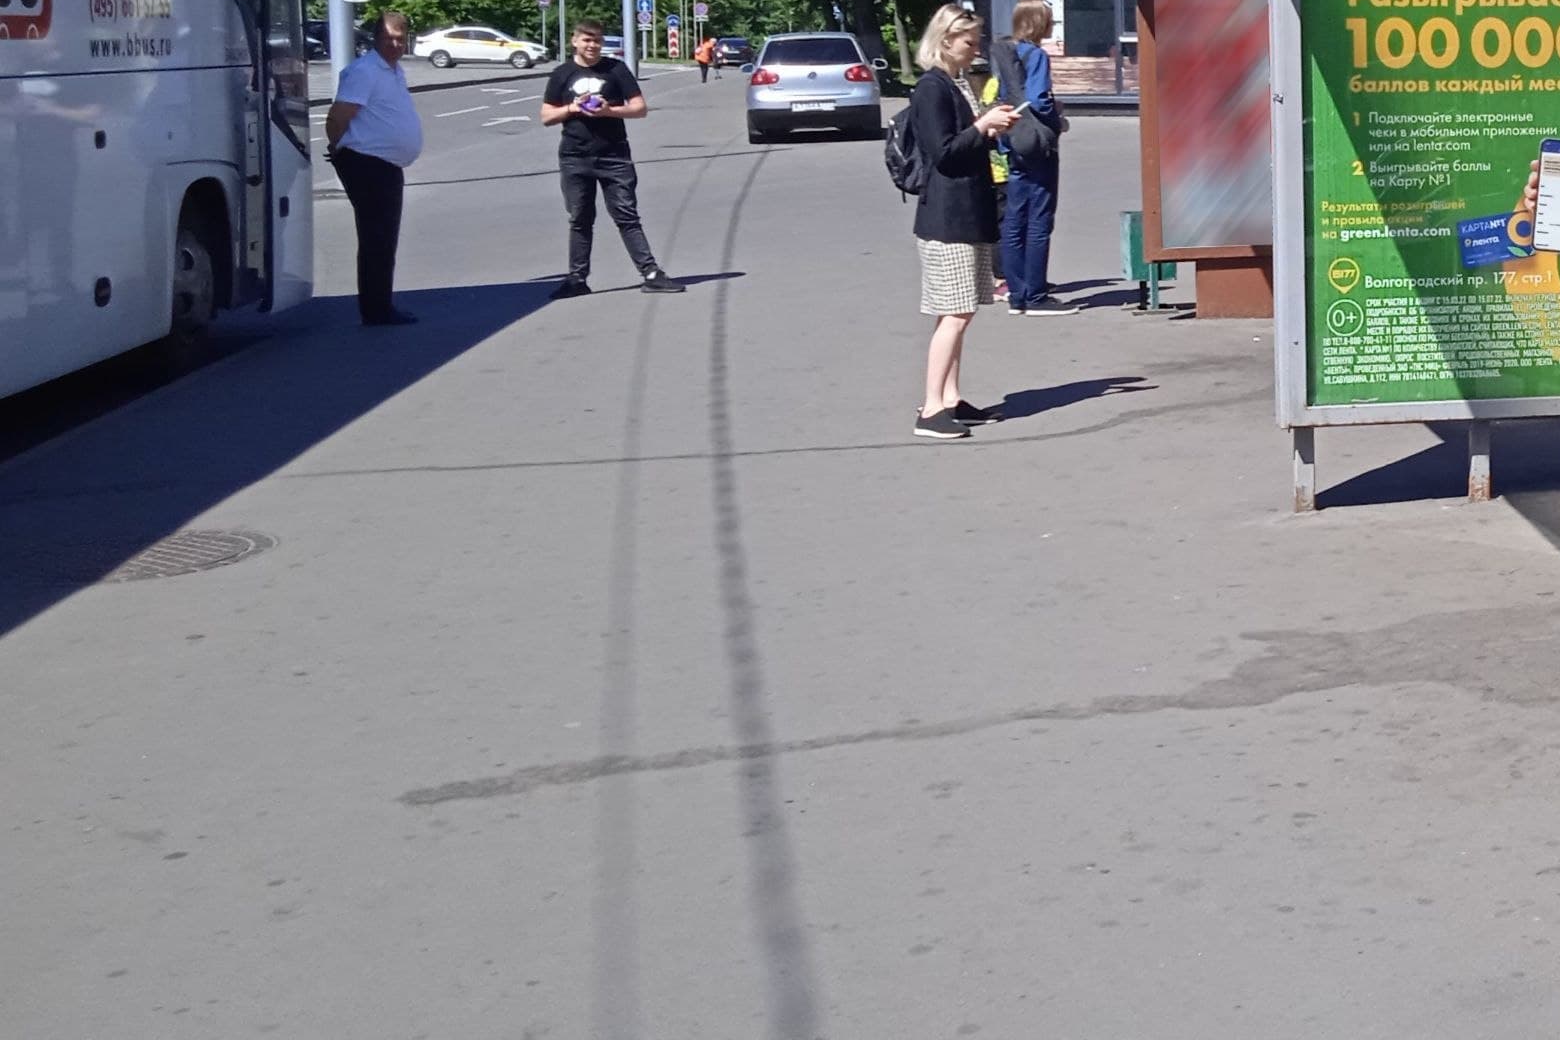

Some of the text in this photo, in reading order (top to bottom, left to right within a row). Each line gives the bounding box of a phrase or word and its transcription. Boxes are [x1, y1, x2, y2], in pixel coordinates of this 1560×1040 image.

[89, 32, 172, 57] www.bbus.ru
[1345, 16, 1460, 69] 100
[1350, 77, 1430, 94] баллов
[1435, 74, 1523, 94] каждый
[1368, 112, 1452, 124] Подключайте
[1455, 112, 1534, 124] электронные
[1368, 125, 1558, 138] чеки в мобильном приложении
[1369, 139, 1471, 152] или на lenta.com
[1370, 162, 1450, 175] Выигрывайте
[1453, 159, 1491, 172] баллы
[1370, 178, 1385, 187] на
[1388, 174, 1425, 189] Карту
[1332, 215, 1384, 228] правила
[1322, 225, 1451, 243] на green.lenta.com
[1365, 274, 1464, 291] Волгоградский
[1467, 276, 1488, 288] пр.
[1332, 309, 1357, 327] 0+
